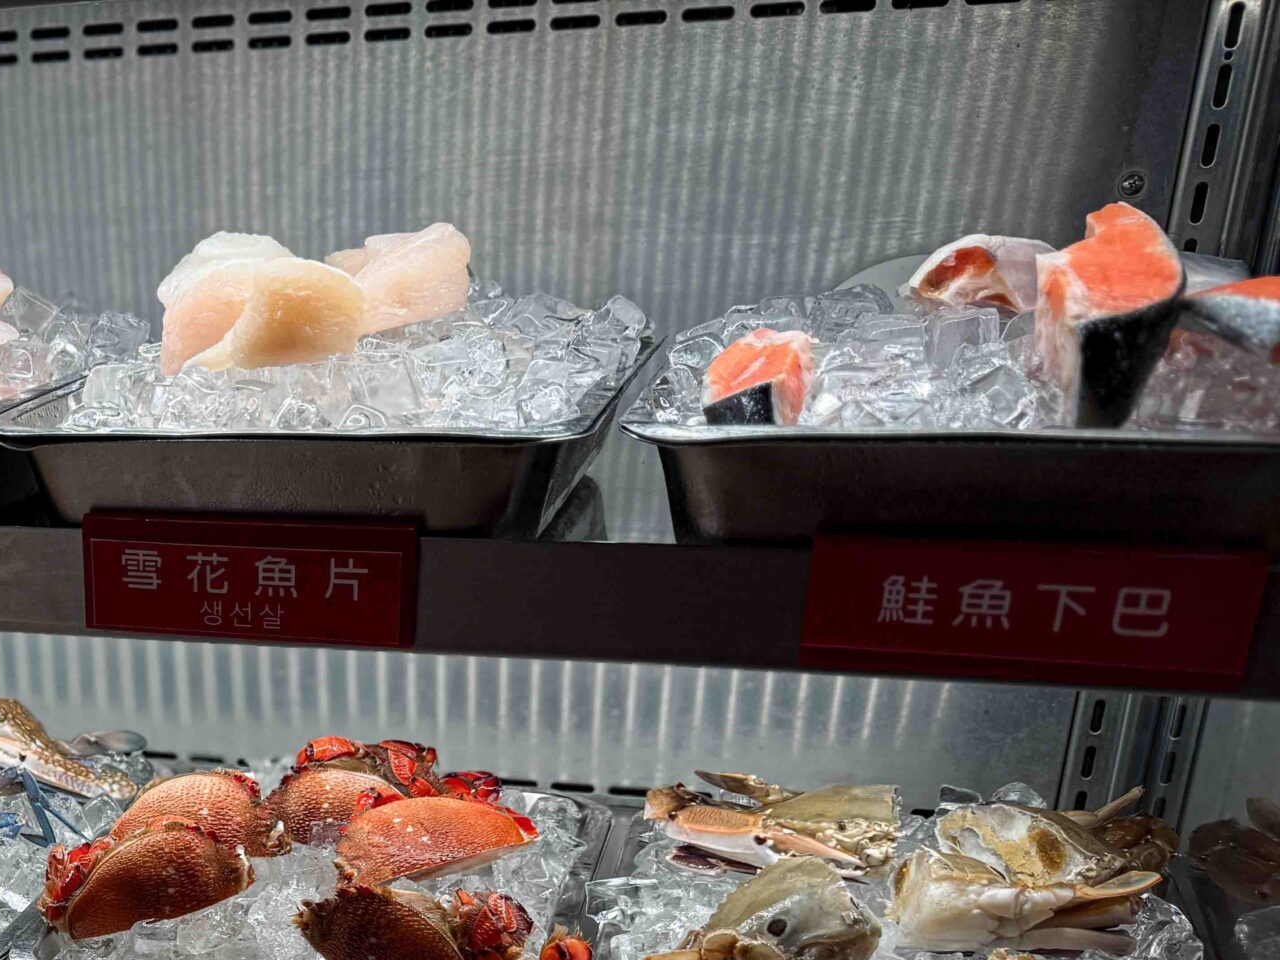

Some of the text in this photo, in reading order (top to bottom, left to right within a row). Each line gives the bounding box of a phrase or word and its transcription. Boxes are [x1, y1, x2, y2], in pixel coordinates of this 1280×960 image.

[121, 548, 369, 602] 雪花魚片
[199, 600, 285, 630] 생선살
[877, 574, 1171, 638] 鮭魚下巴
